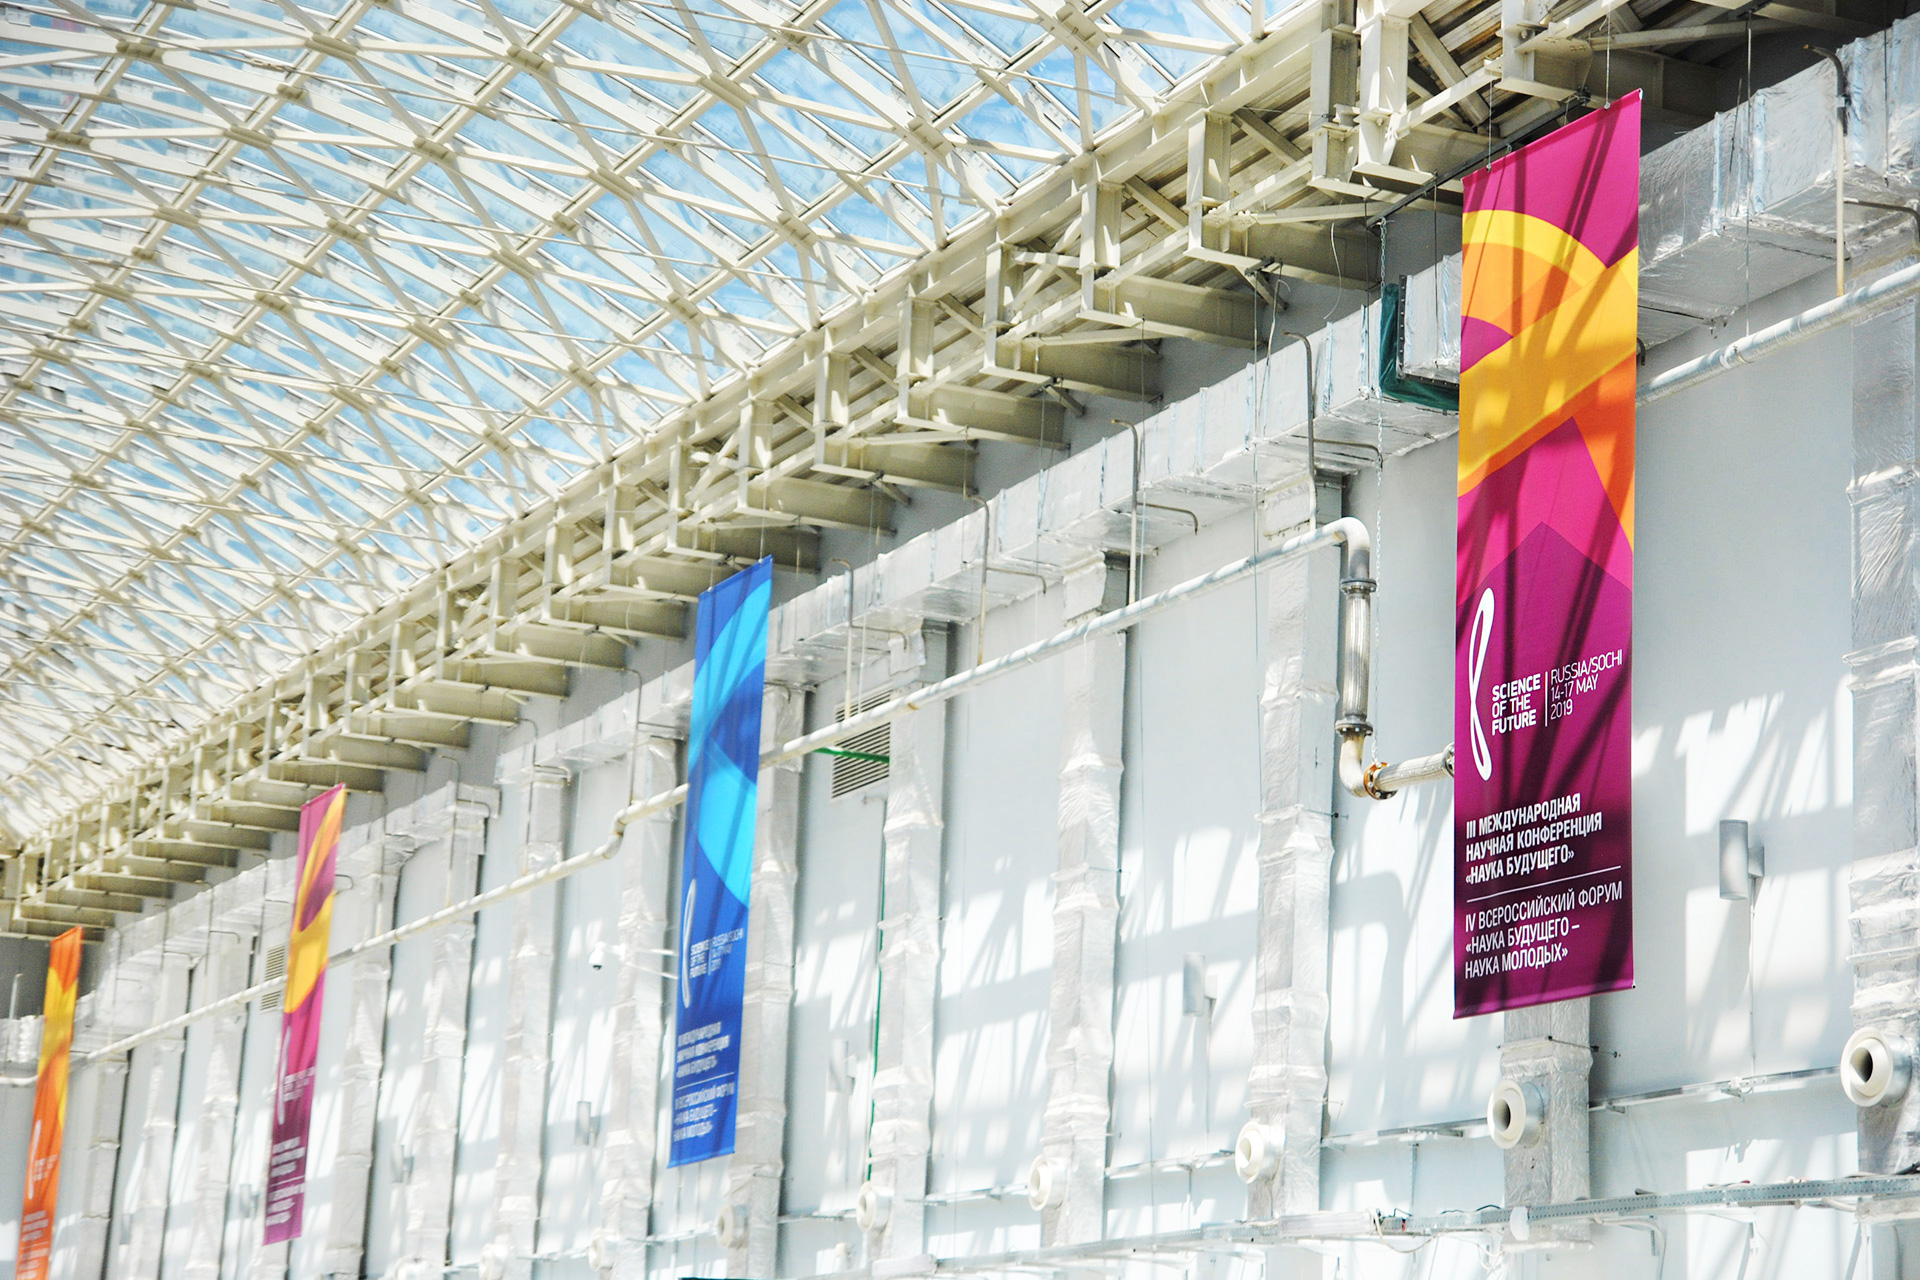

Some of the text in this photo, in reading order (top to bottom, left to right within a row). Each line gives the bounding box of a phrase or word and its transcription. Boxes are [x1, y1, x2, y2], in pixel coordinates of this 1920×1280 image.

[1551, 649, 1622, 684] RUSSIA/SOCHI
[1492, 673, 1541, 702] SCIENCE
[1551, 675, 1599, 703] 14-17 MAY
[1492, 693, 1531, 719] OF THE
[1492, 709, 1537, 736] FUTURE
[1550, 698, 1573, 720] 2019
[1466, 793, 1581, 839] III МЕЖДУНАРОДНАЯ
[1466, 812, 1602, 862] НАУЧНАЯ КОНФЕРЕНЦИЯ
[1465, 844, 1574, 885] «НАУКА БУДУЩЕГО»
[1465, 881, 1623, 933] IV ВСЕРОССИЙСКИЙ ФОРУМ
[1465, 934, 1506, 955] «НАУКА
[1507, 917, 1569, 948] БУДУЩЕГО
[1465, 942, 1569, 979] НАУКА МОЛОДЫХ»
